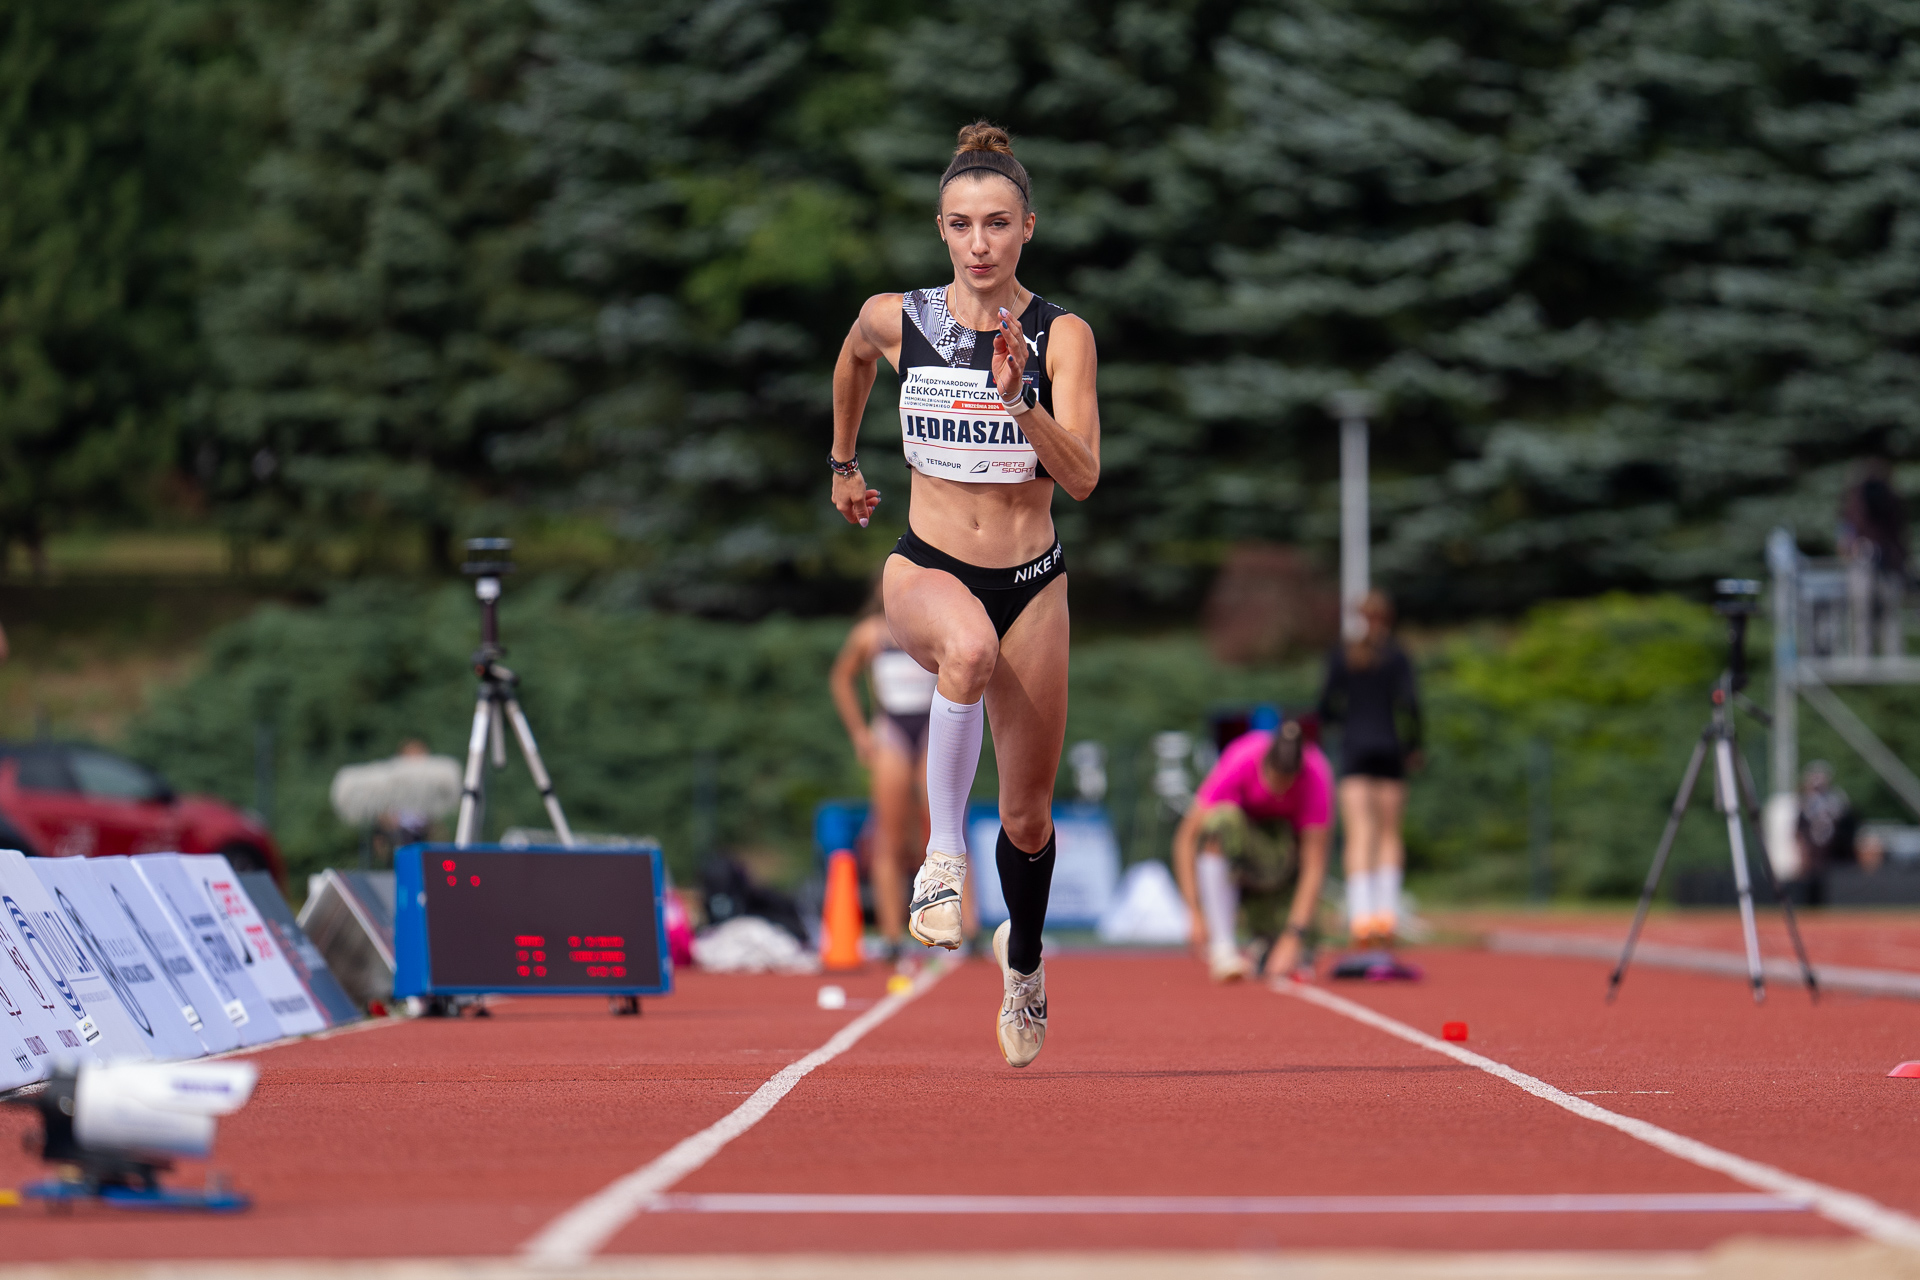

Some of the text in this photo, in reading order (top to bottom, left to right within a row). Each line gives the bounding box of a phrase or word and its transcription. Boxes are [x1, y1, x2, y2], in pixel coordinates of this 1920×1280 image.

[909, 373, 978, 388] IV MIĘDZYNARODOWY
[905, 385, 1000, 400] LEKKOATLETYCZNY
[926, 457, 962, 469] TETRAPUR
[1013, 555, 1052, 583] NIKE
[929, 868, 957, 884] NIKE
